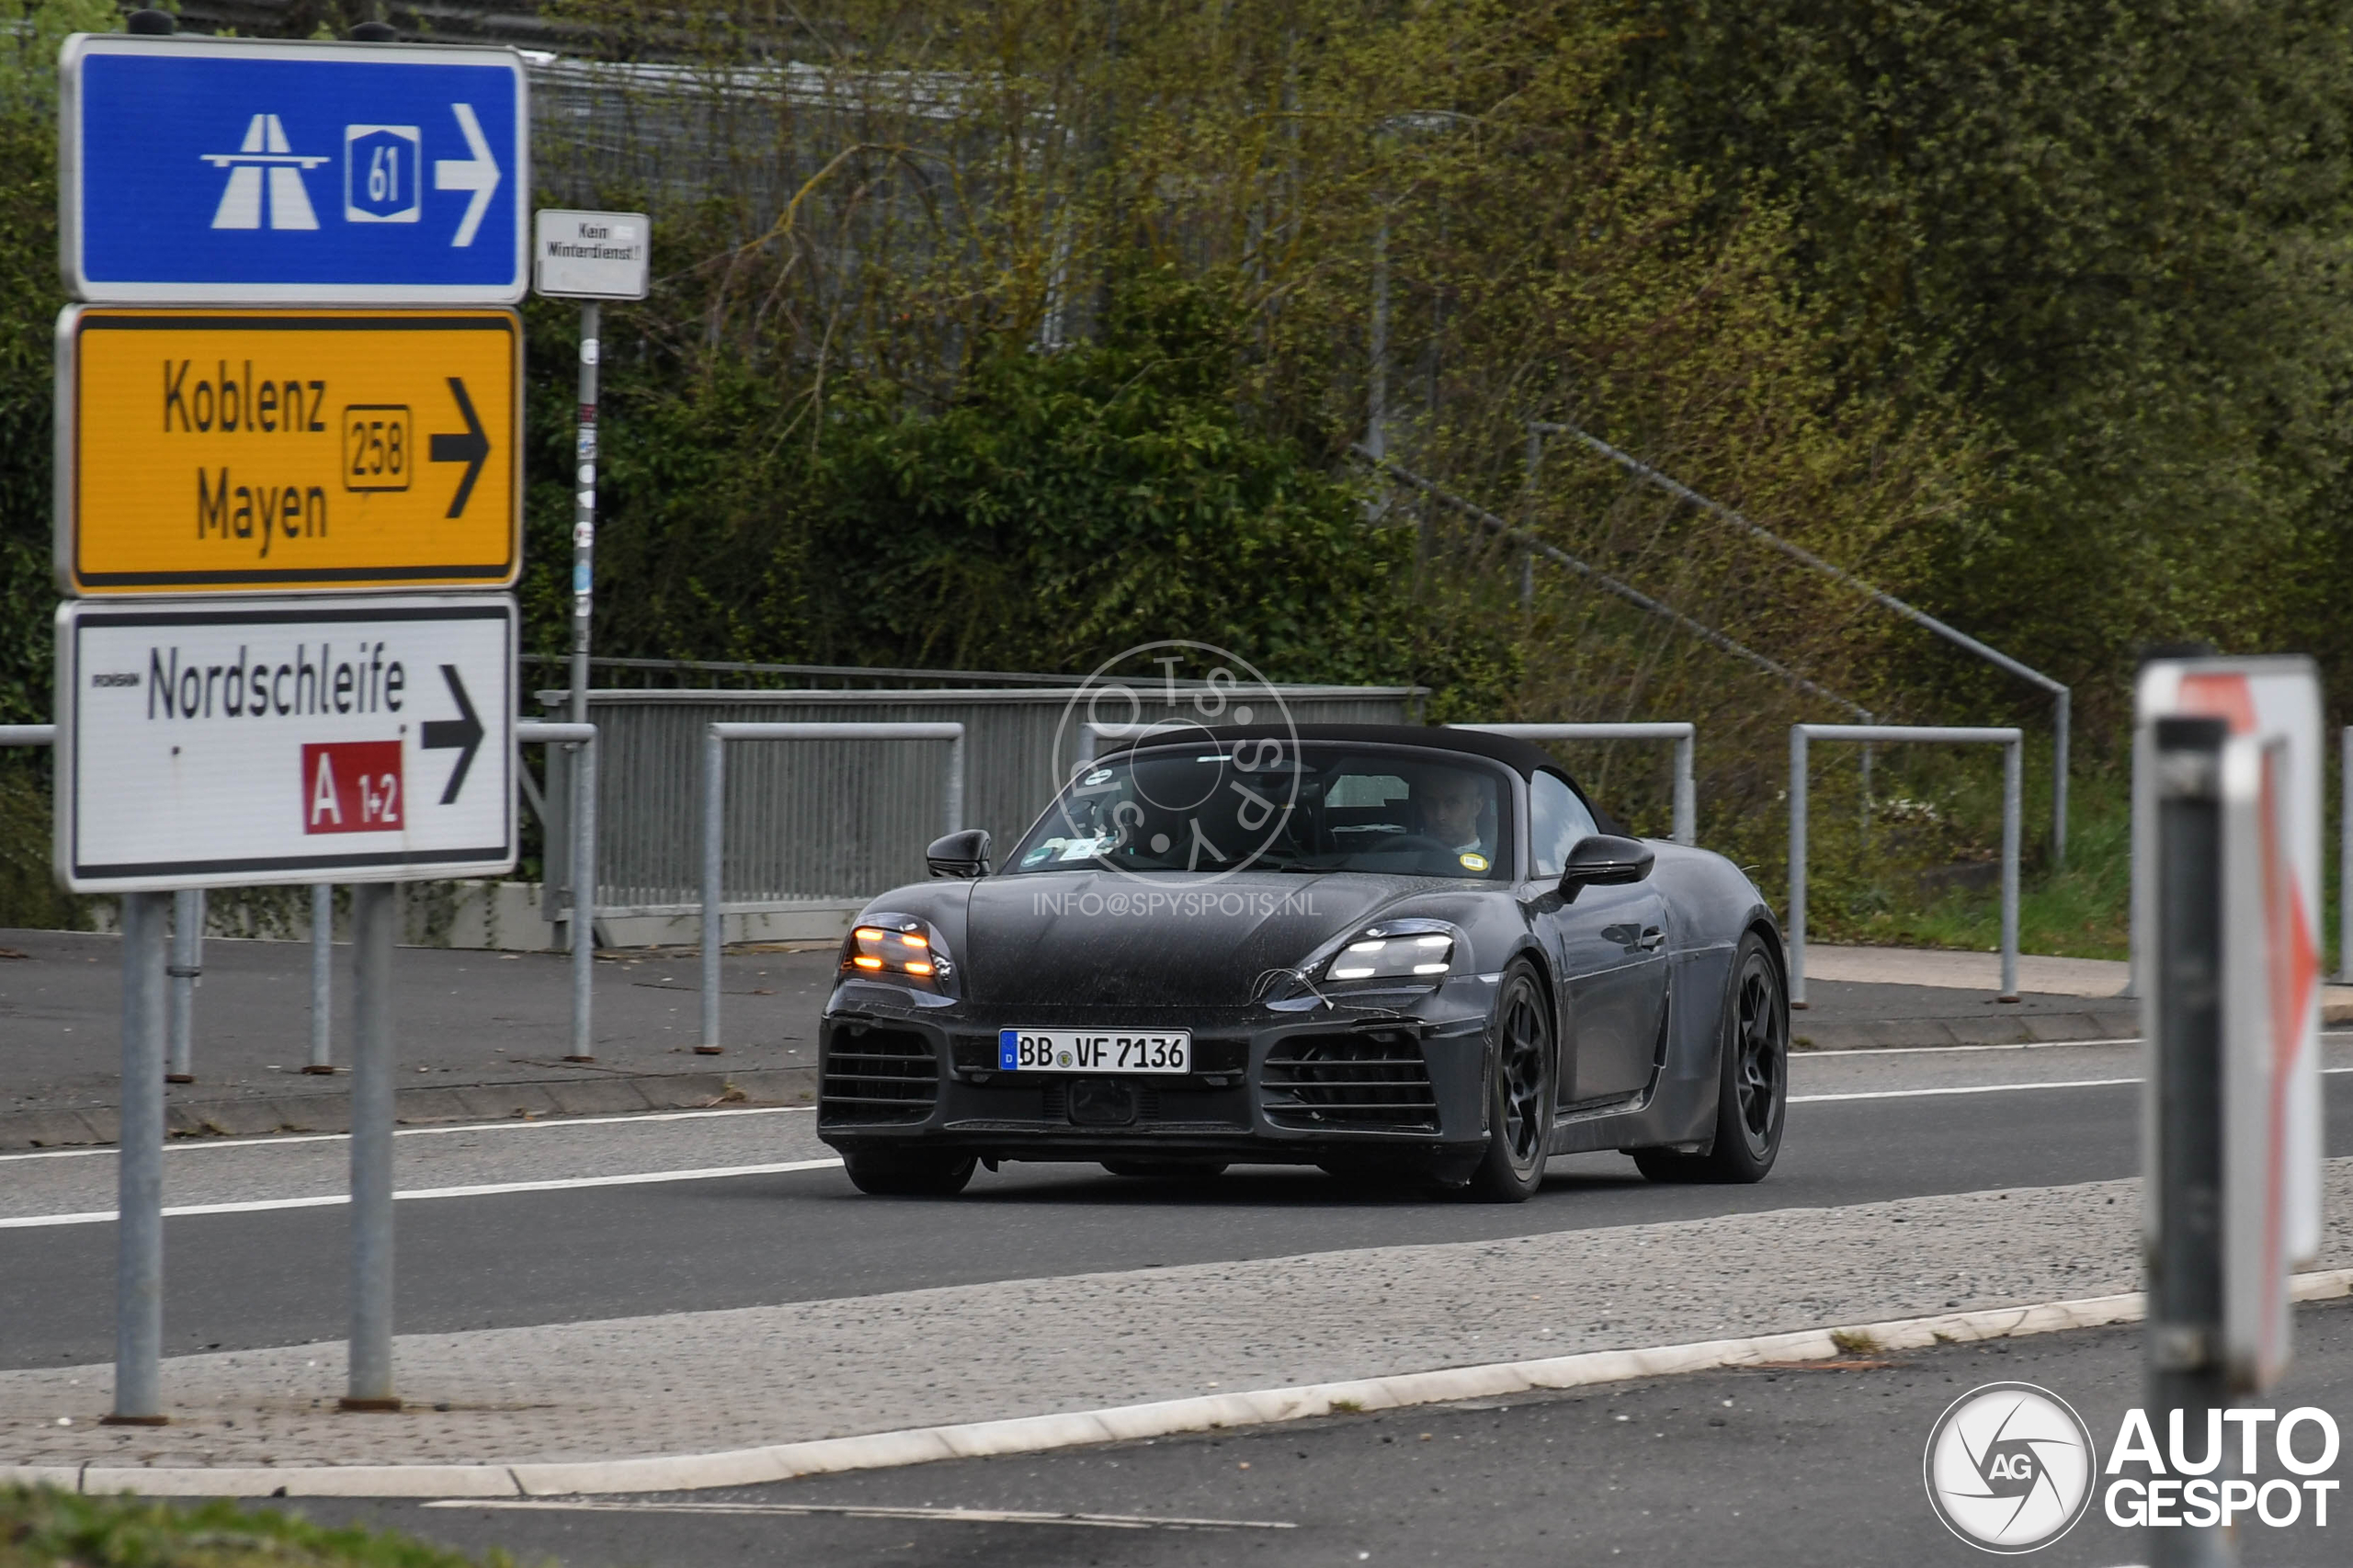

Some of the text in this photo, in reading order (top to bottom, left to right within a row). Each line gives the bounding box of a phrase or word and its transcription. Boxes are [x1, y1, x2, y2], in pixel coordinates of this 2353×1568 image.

[368, 145, 398, 202] 61
[578, 222, 608, 239] Kein
[164, 359, 326, 434] Koblenz
[350, 421, 402, 476] 258
[198, 466, 327, 559] Mayen
[148, 642, 405, 720] Nordschleife
[311, 752, 398, 825] A 1+2
[1005, 1053, 1013, 1063] D
[1019, 1036, 1184, 1068] BB VF 7136
